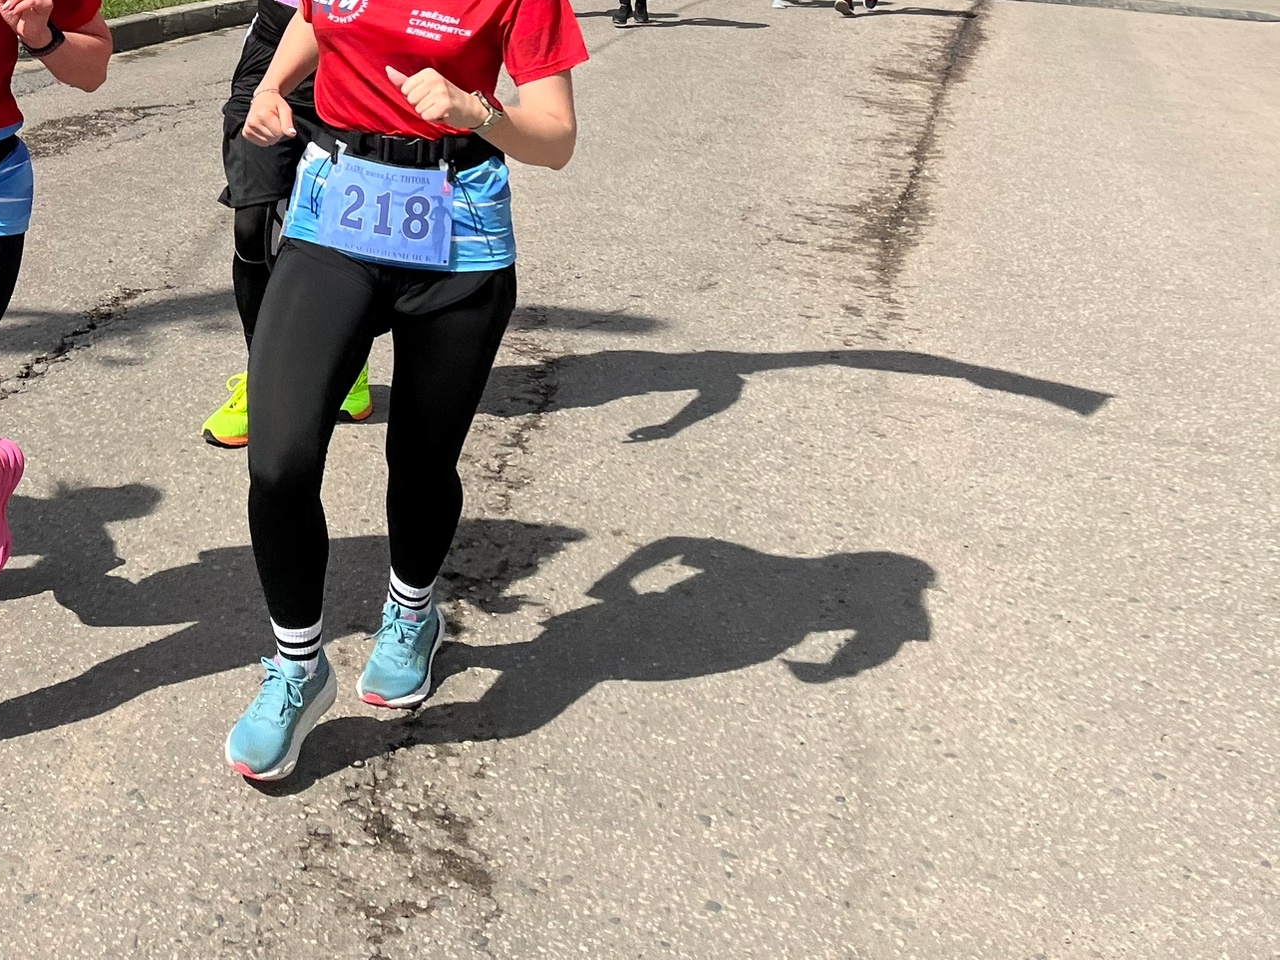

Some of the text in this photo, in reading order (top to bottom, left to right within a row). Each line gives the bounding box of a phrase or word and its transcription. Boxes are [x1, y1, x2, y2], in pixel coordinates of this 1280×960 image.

[406, 27, 441, 41] БЛИЖЕ
[409, 18, 473, 37] СТАНОВЯТСЯ
[340, 184, 431, 240] 218
